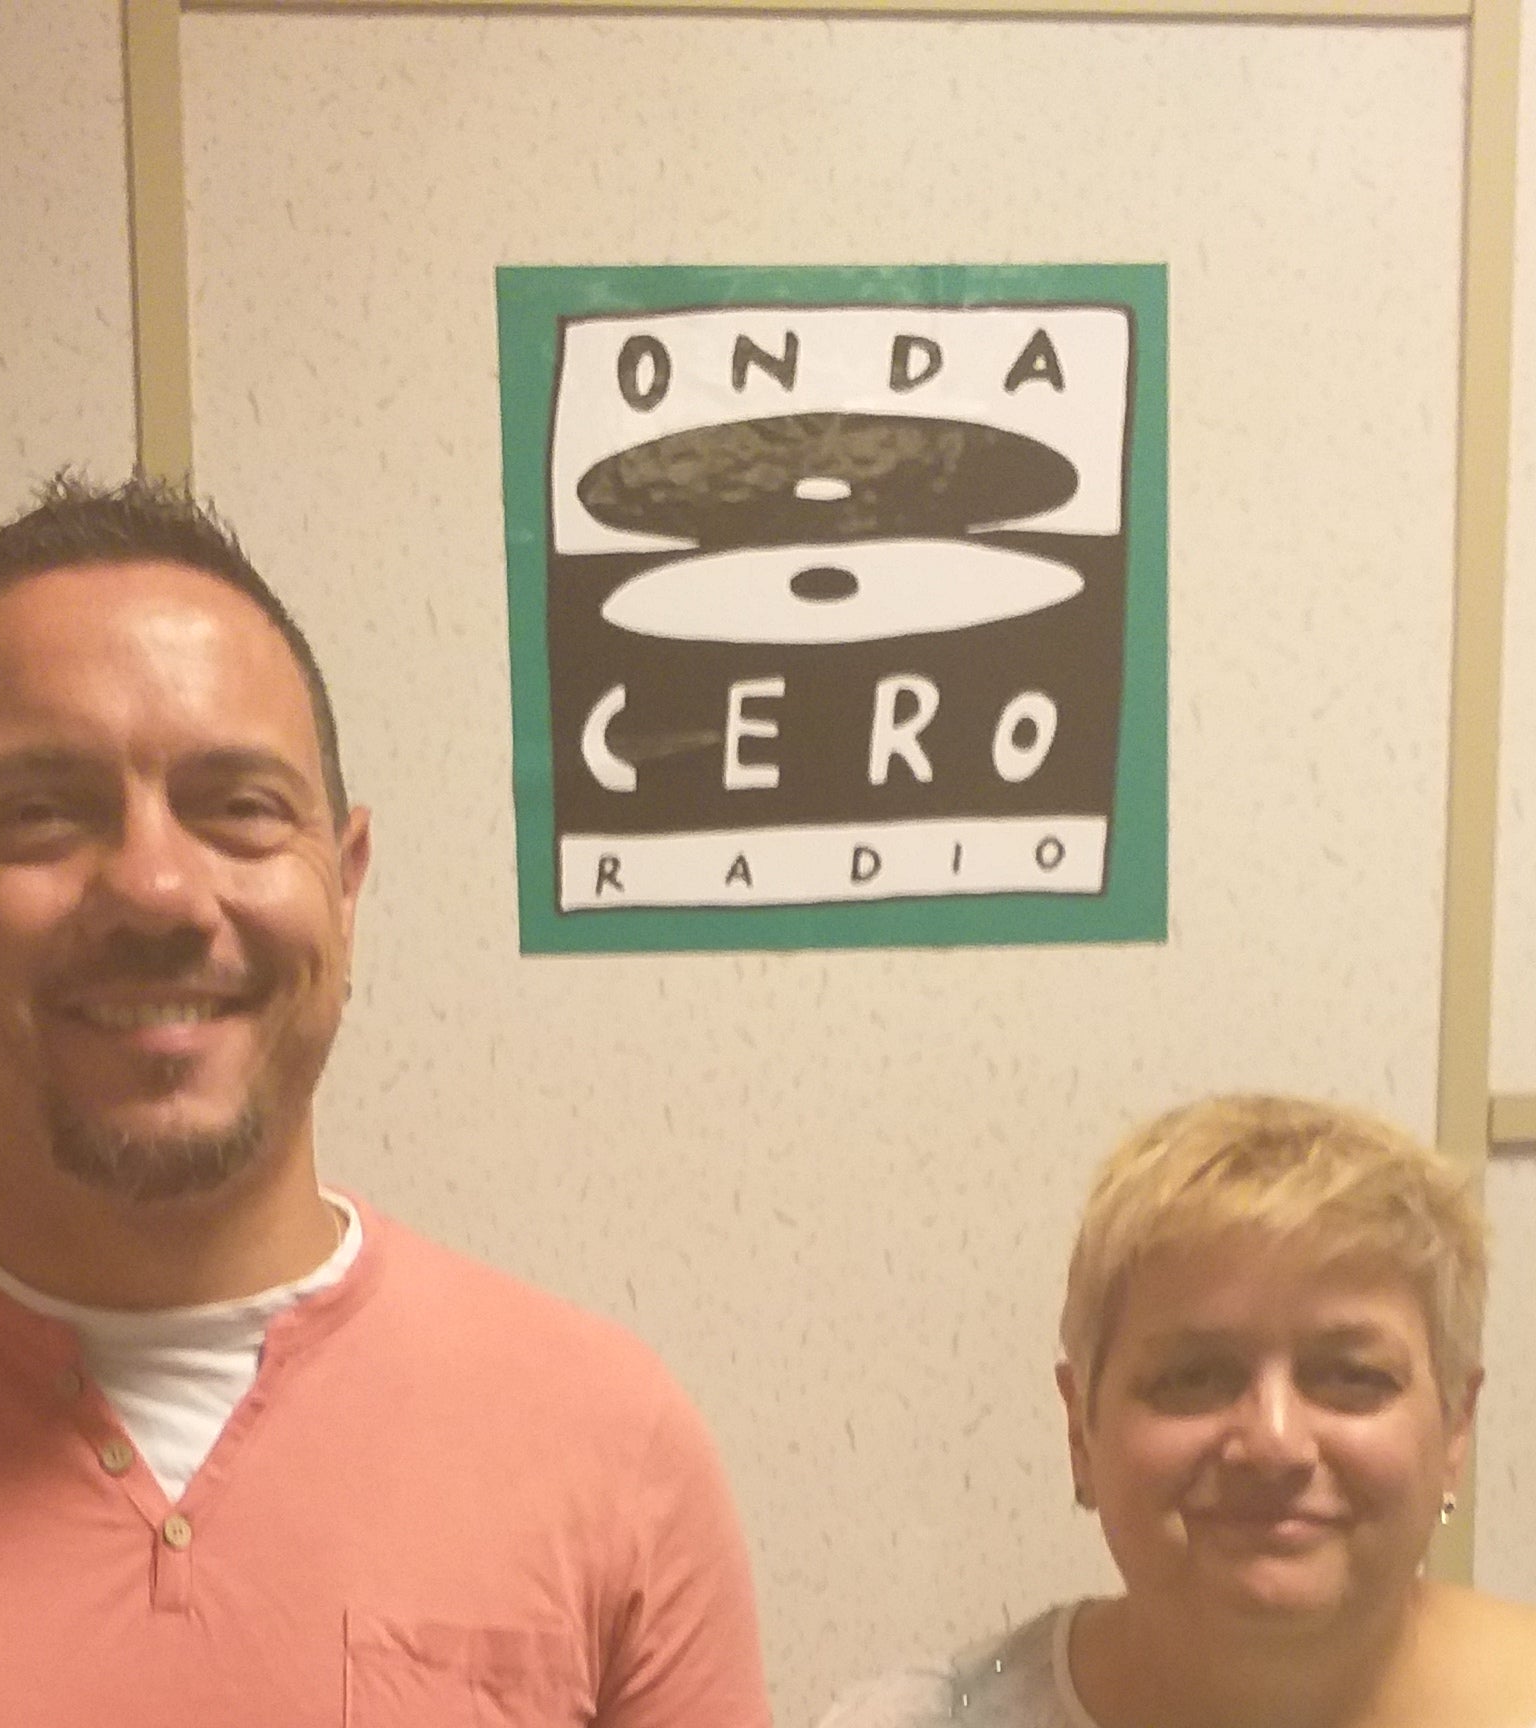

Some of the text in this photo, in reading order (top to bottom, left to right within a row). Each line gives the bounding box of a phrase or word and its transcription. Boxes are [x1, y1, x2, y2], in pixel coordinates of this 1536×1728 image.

[617, 328, 1066, 413] ONDA
[580, 673, 1059, 793] CERO
[594, 835, 1066, 897] RADIO
